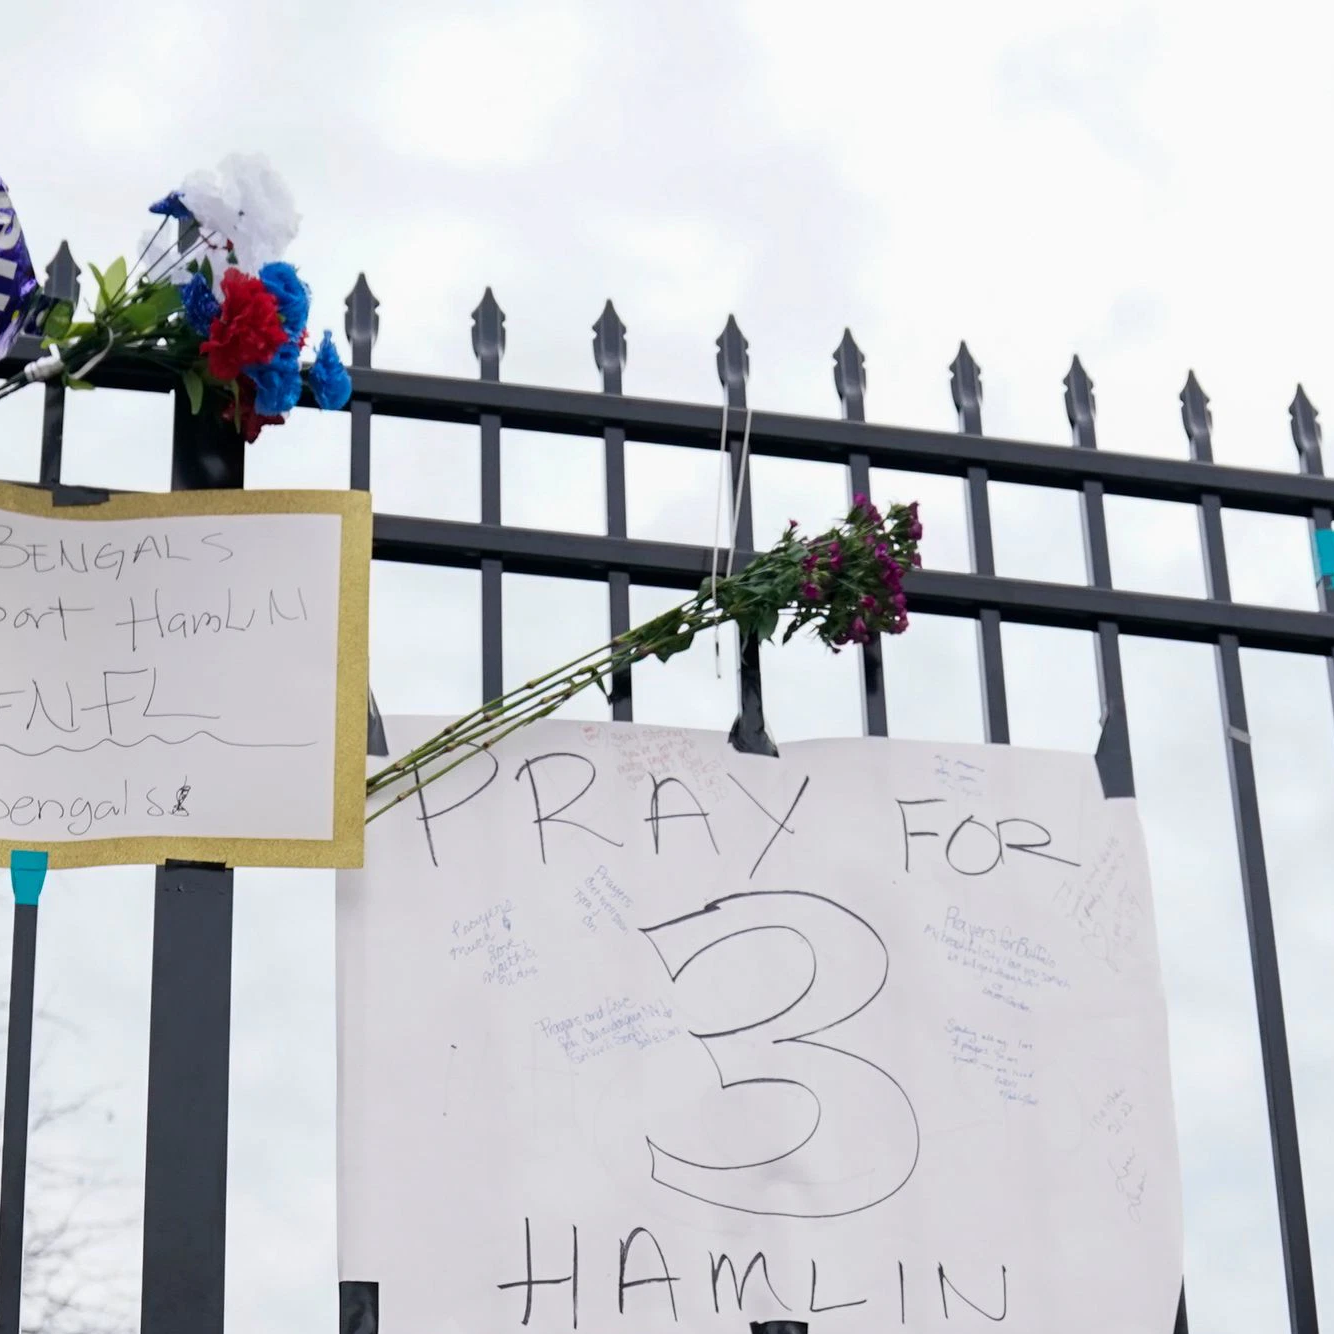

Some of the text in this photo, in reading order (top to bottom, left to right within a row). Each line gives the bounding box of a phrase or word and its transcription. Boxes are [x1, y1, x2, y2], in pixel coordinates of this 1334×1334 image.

[412, 740, 811, 880] PRAY
[895, 799, 1082, 875] FOR
[638, 889, 920, 1219] 3
[497, 1217, 1008, 1329] HAMLIN
